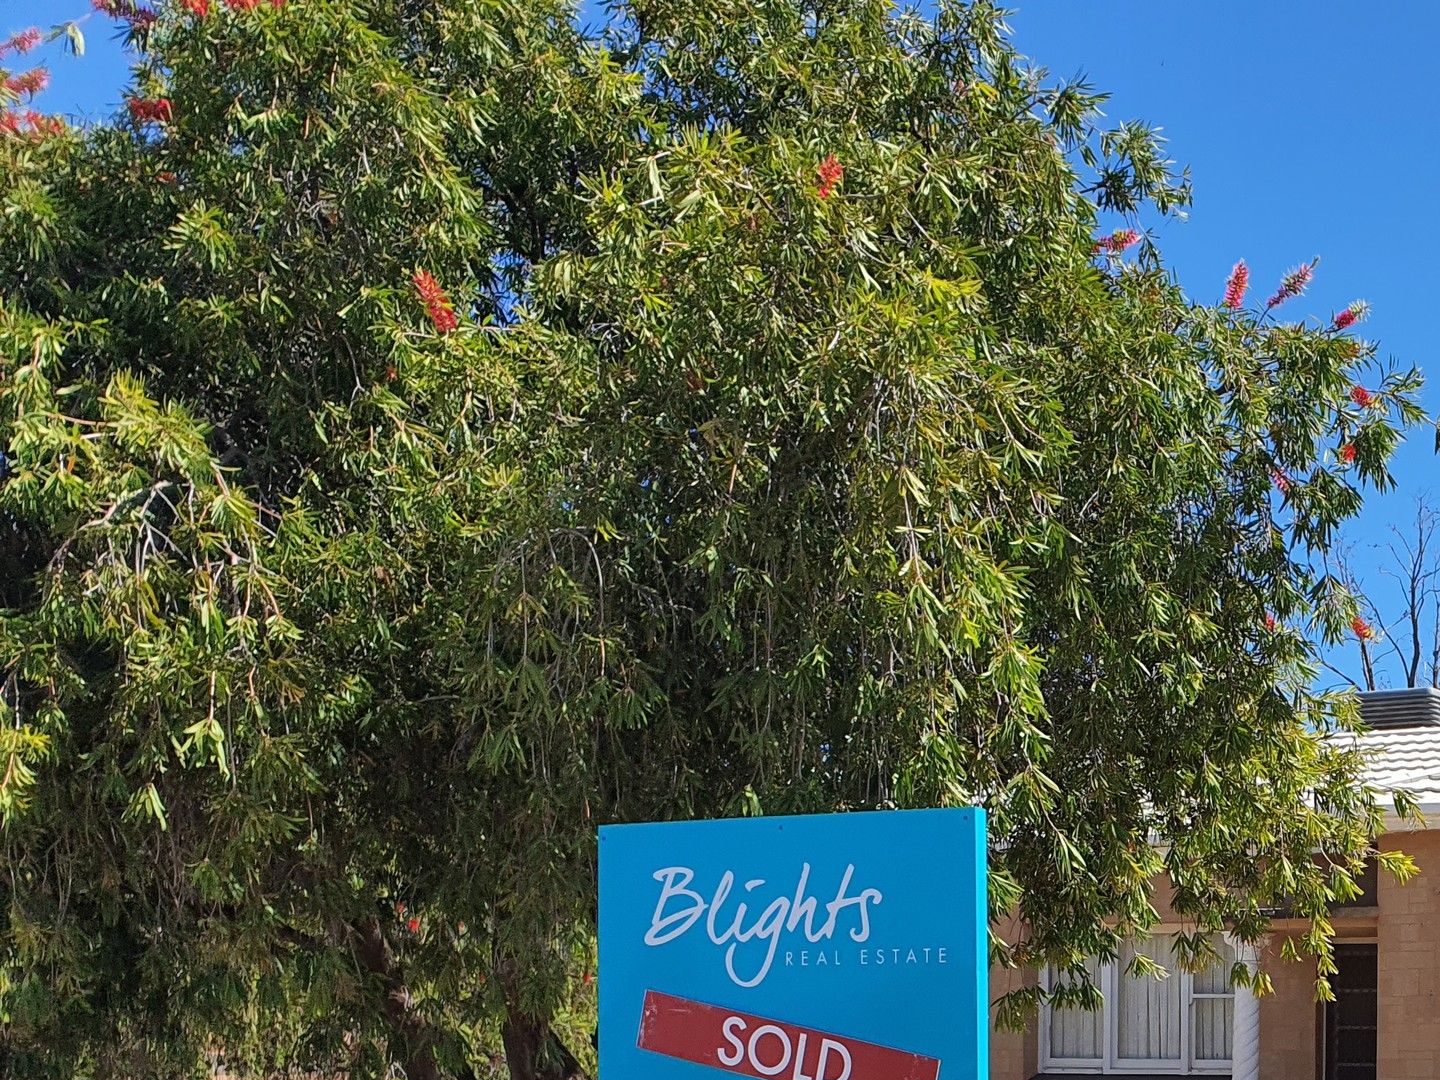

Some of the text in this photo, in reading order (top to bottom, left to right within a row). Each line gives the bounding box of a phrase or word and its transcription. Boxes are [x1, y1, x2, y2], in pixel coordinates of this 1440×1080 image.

[644, 862, 883, 988] Blights
[785, 948, 947, 966] REAL ESTATE
